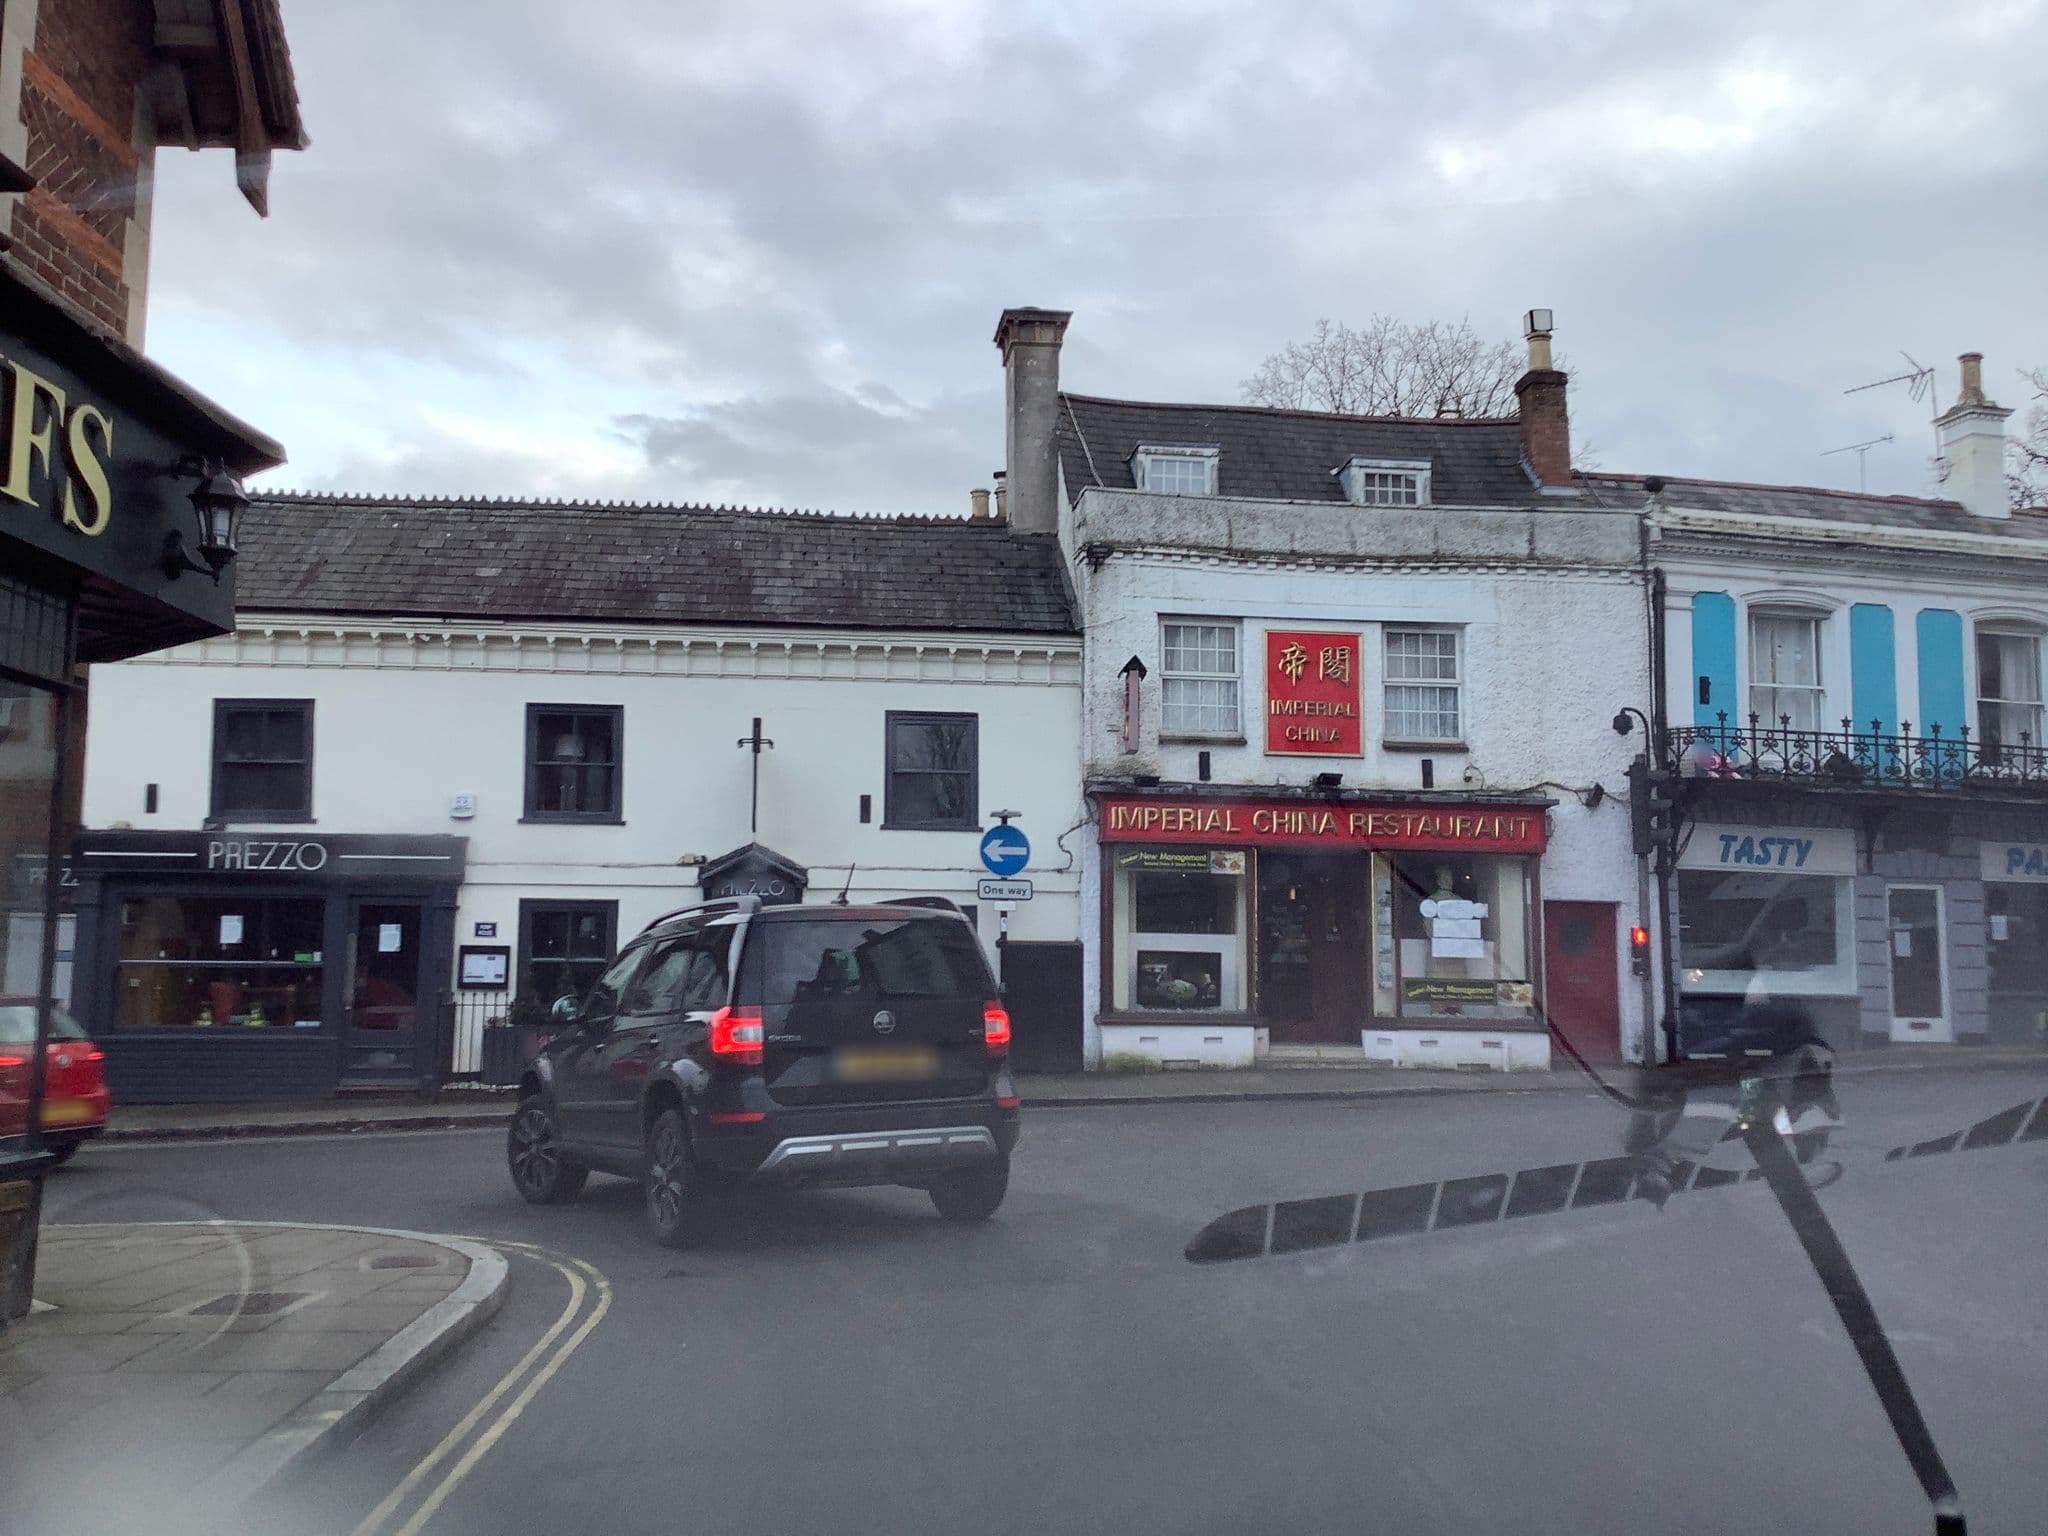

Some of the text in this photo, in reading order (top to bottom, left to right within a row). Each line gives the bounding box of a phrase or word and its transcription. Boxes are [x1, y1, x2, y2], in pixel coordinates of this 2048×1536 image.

[0, 353, 114, 537] FS
[1271, 699, 1358, 718] IMPERIAL
[1285, 726, 1341, 742] CHINA
[1110, 806, 1533, 839] IMPERIAL CHINA RESTAURANT
[208, 841, 328, 871] PREZZO
[1719, 834, 1813, 867] TASTY
[983, 885, 1028, 897] One way
